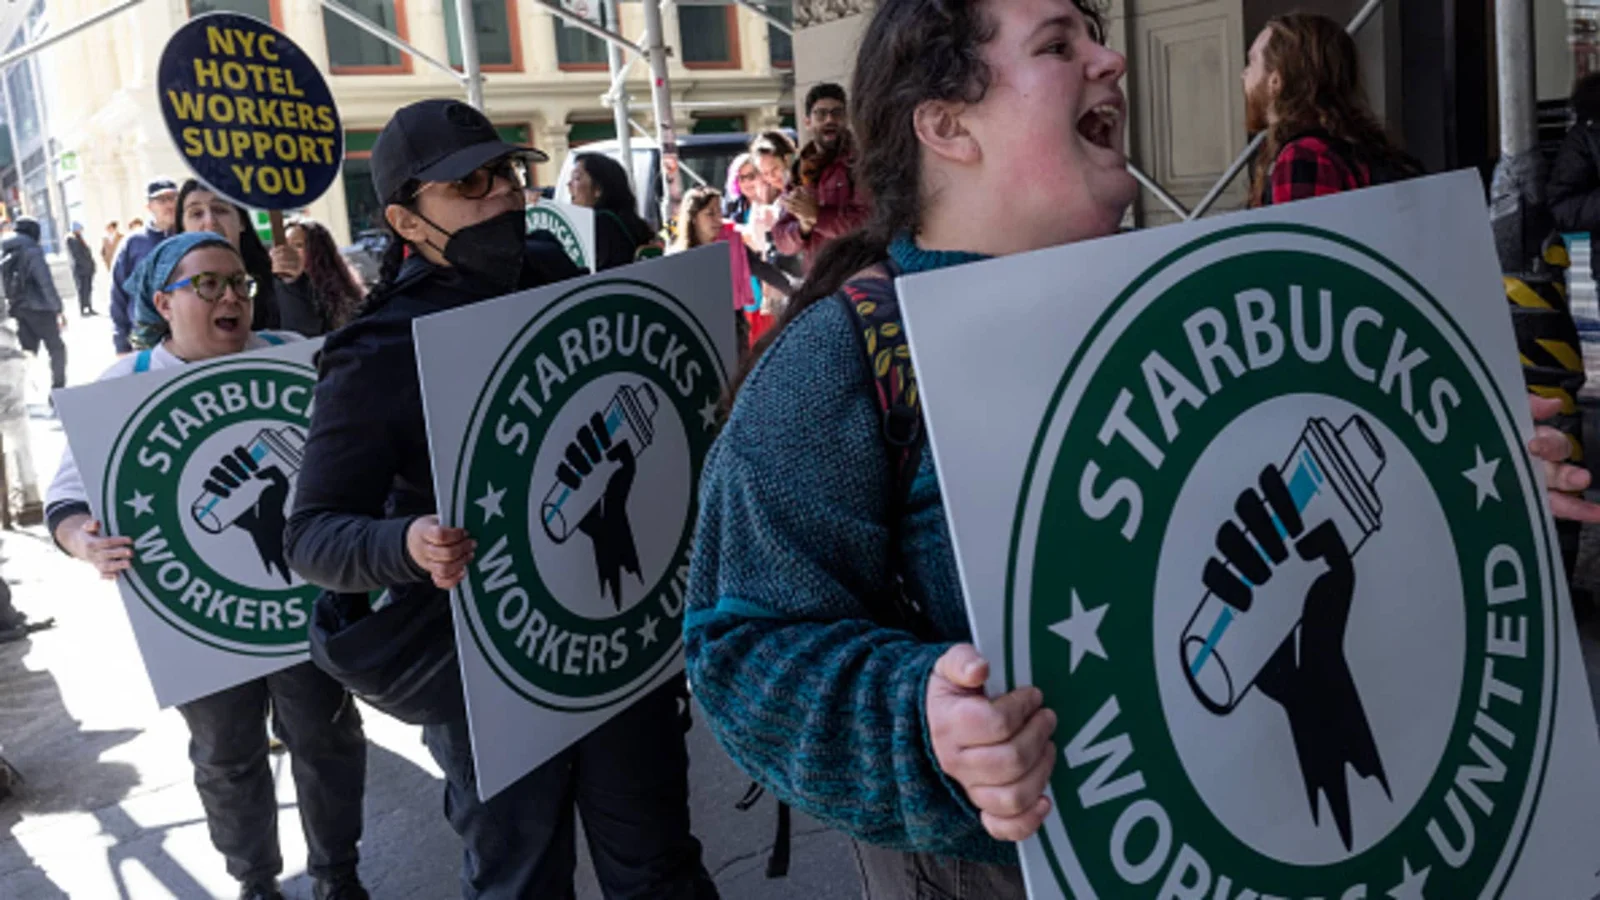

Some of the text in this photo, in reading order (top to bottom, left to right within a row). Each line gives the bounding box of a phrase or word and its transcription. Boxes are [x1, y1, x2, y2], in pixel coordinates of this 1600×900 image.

[193, 58, 304, 97] HOTEL
[206, 26, 279, 61] NYC
[167, 89, 336, 133] WORKERS
[182, 127, 335, 165] SUPPORT
[232, 164, 306, 195] YOU
[496, 313, 701, 456] STARBUCKS
[1078, 285, 1462, 541] STARBUCKS
[134, 526, 308, 631] WORKERS
[477, 535, 629, 676] WORKERS
[1426, 543, 1527, 868] UNITED
